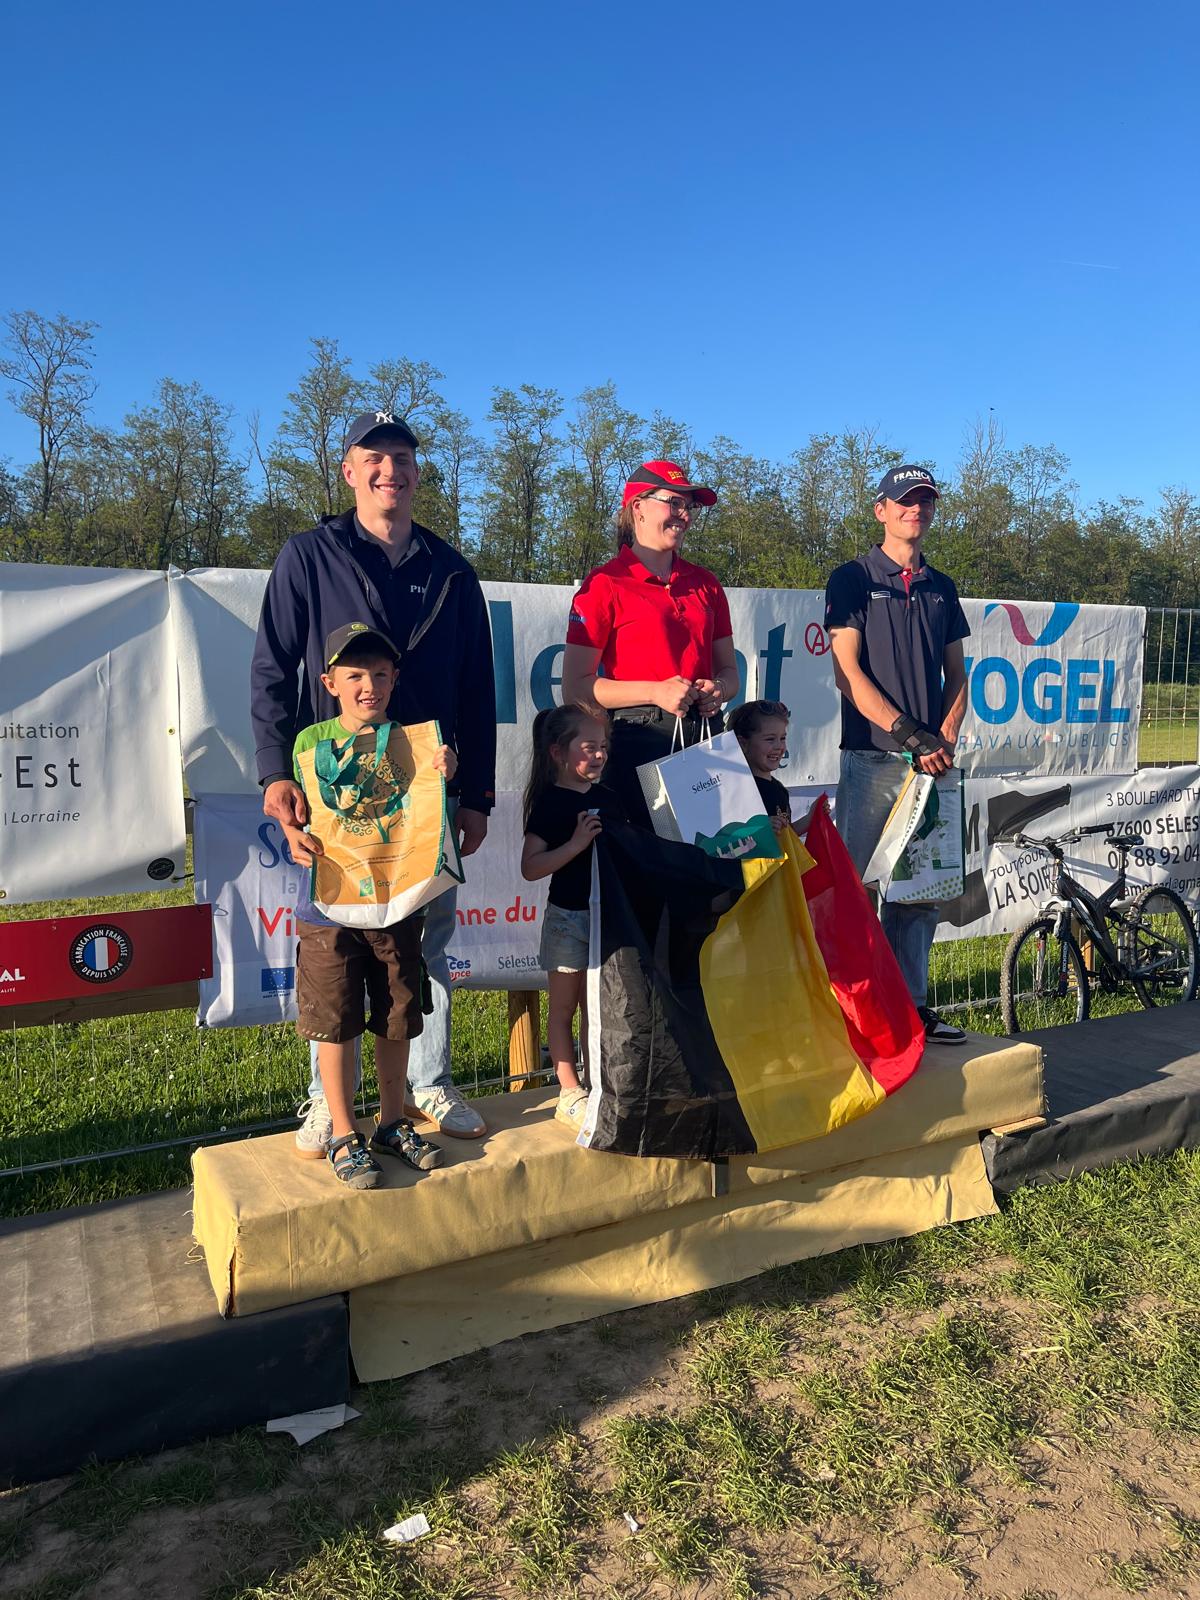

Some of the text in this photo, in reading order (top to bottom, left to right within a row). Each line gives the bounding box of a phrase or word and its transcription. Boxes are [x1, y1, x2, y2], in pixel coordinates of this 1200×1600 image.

[964, 656, 1131, 724] OGEL
[958, 731, 1129, 751] RAVAUX PUBLICS
[1106, 793, 1113, 806] 3
[1116, 788, 1183, 806] BOULEVARD
[12, 810, 81, 824] Lorraine
[990, 848, 1045, 879] TOUT POUR
[1134, 847, 1156, 867] 88
[1160, 846, 1180, 865] 92
[993, 881, 1017, 909] LA
[505, 896, 537, 922] du
[75, 930, 104, 964] FABRICATION
[81, 962, 123, 978] DEPUIS 1924
